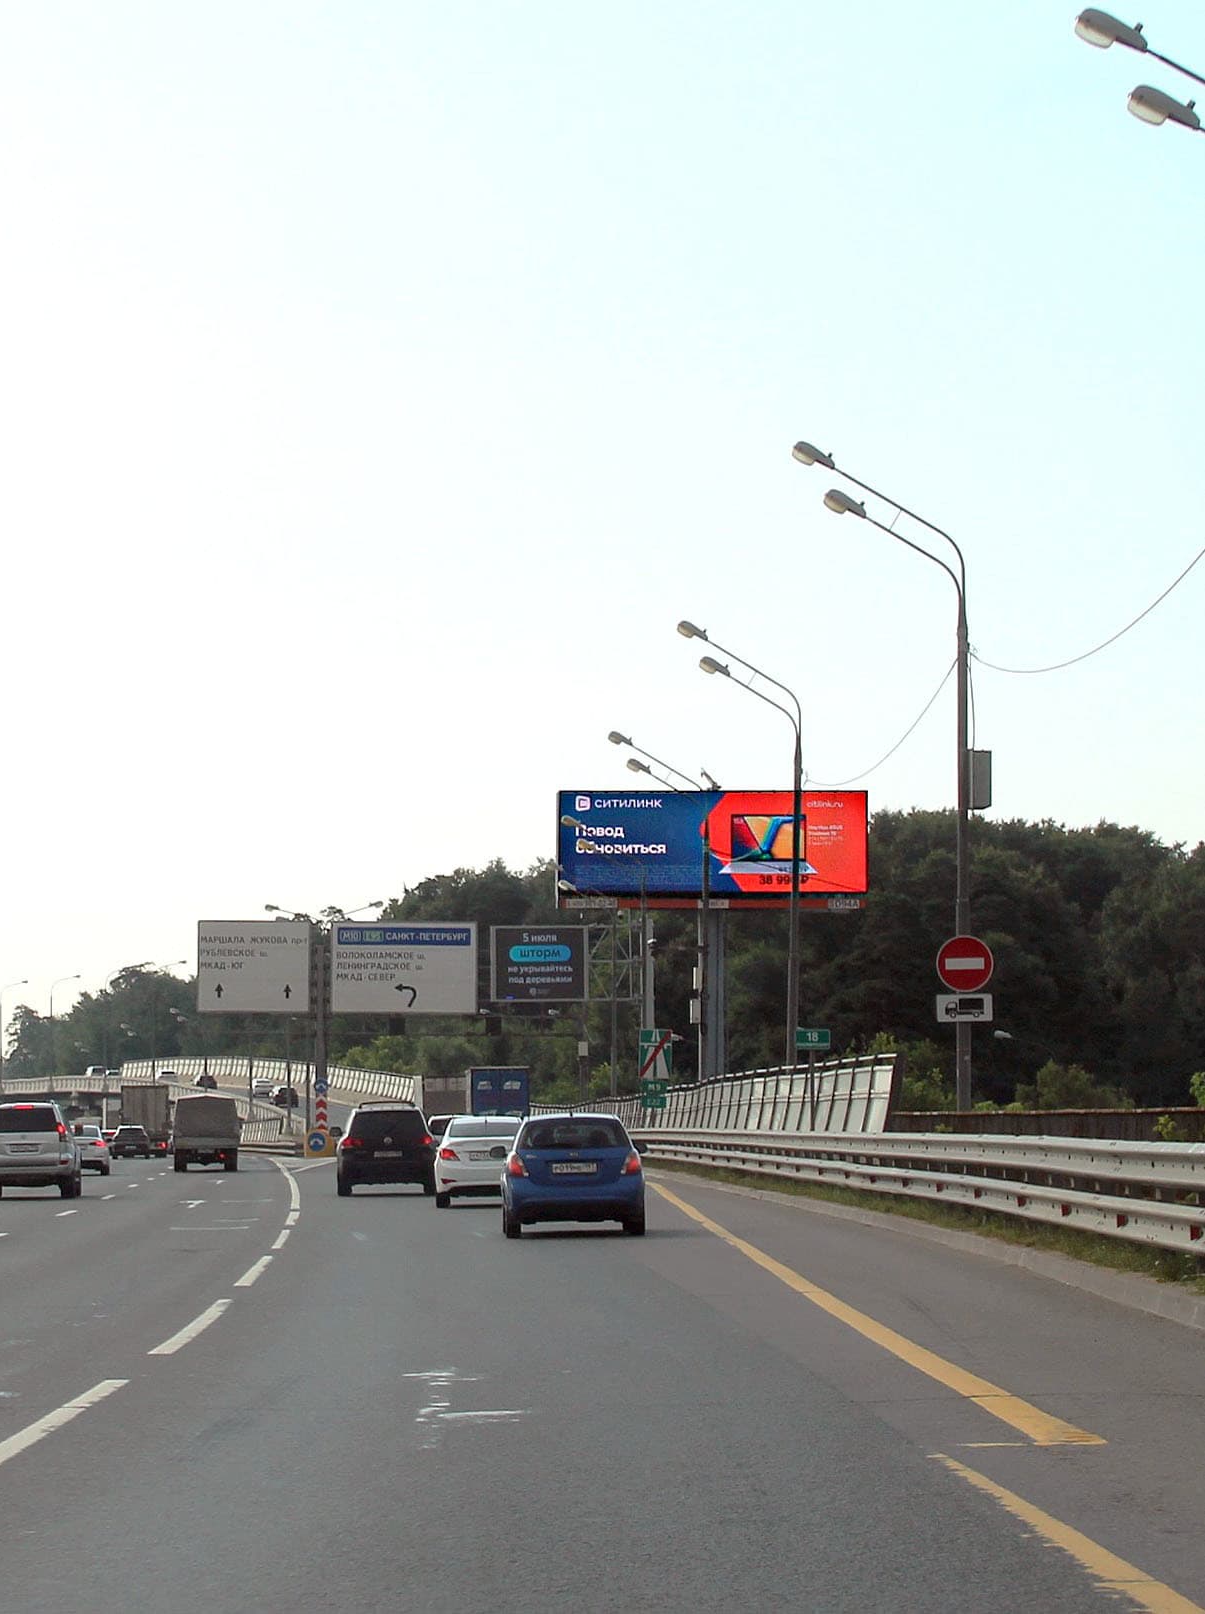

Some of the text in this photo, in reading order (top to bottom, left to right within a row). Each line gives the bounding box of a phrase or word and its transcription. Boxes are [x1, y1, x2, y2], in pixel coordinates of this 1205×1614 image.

[594, 798, 663, 808] СИТИЛИНК
[806, 799, 844, 808] citilink.ru
[576, 824, 625, 838] Повод
[759, 874, 773, 885] 38
[200, 935, 246, 945] МАРШАЛА
[250, 935, 288, 945] ЖУКОВА
[385, 931, 469, 941] САНКТ-ПЕТЕРБУРГ
[522, 932, 557, 943] 5 июля
[336, 951, 414, 960] ВОЛОКОЛАМСКОЕ
[519, 949, 561, 959] шторм
[336, 962, 411, 971] ЛЕНИНГРАДСКОЕ
[519, 964, 573, 974] укрывайтесь
[508, 976, 524, 984] под
[806, 1031, 819, 1042] 18
